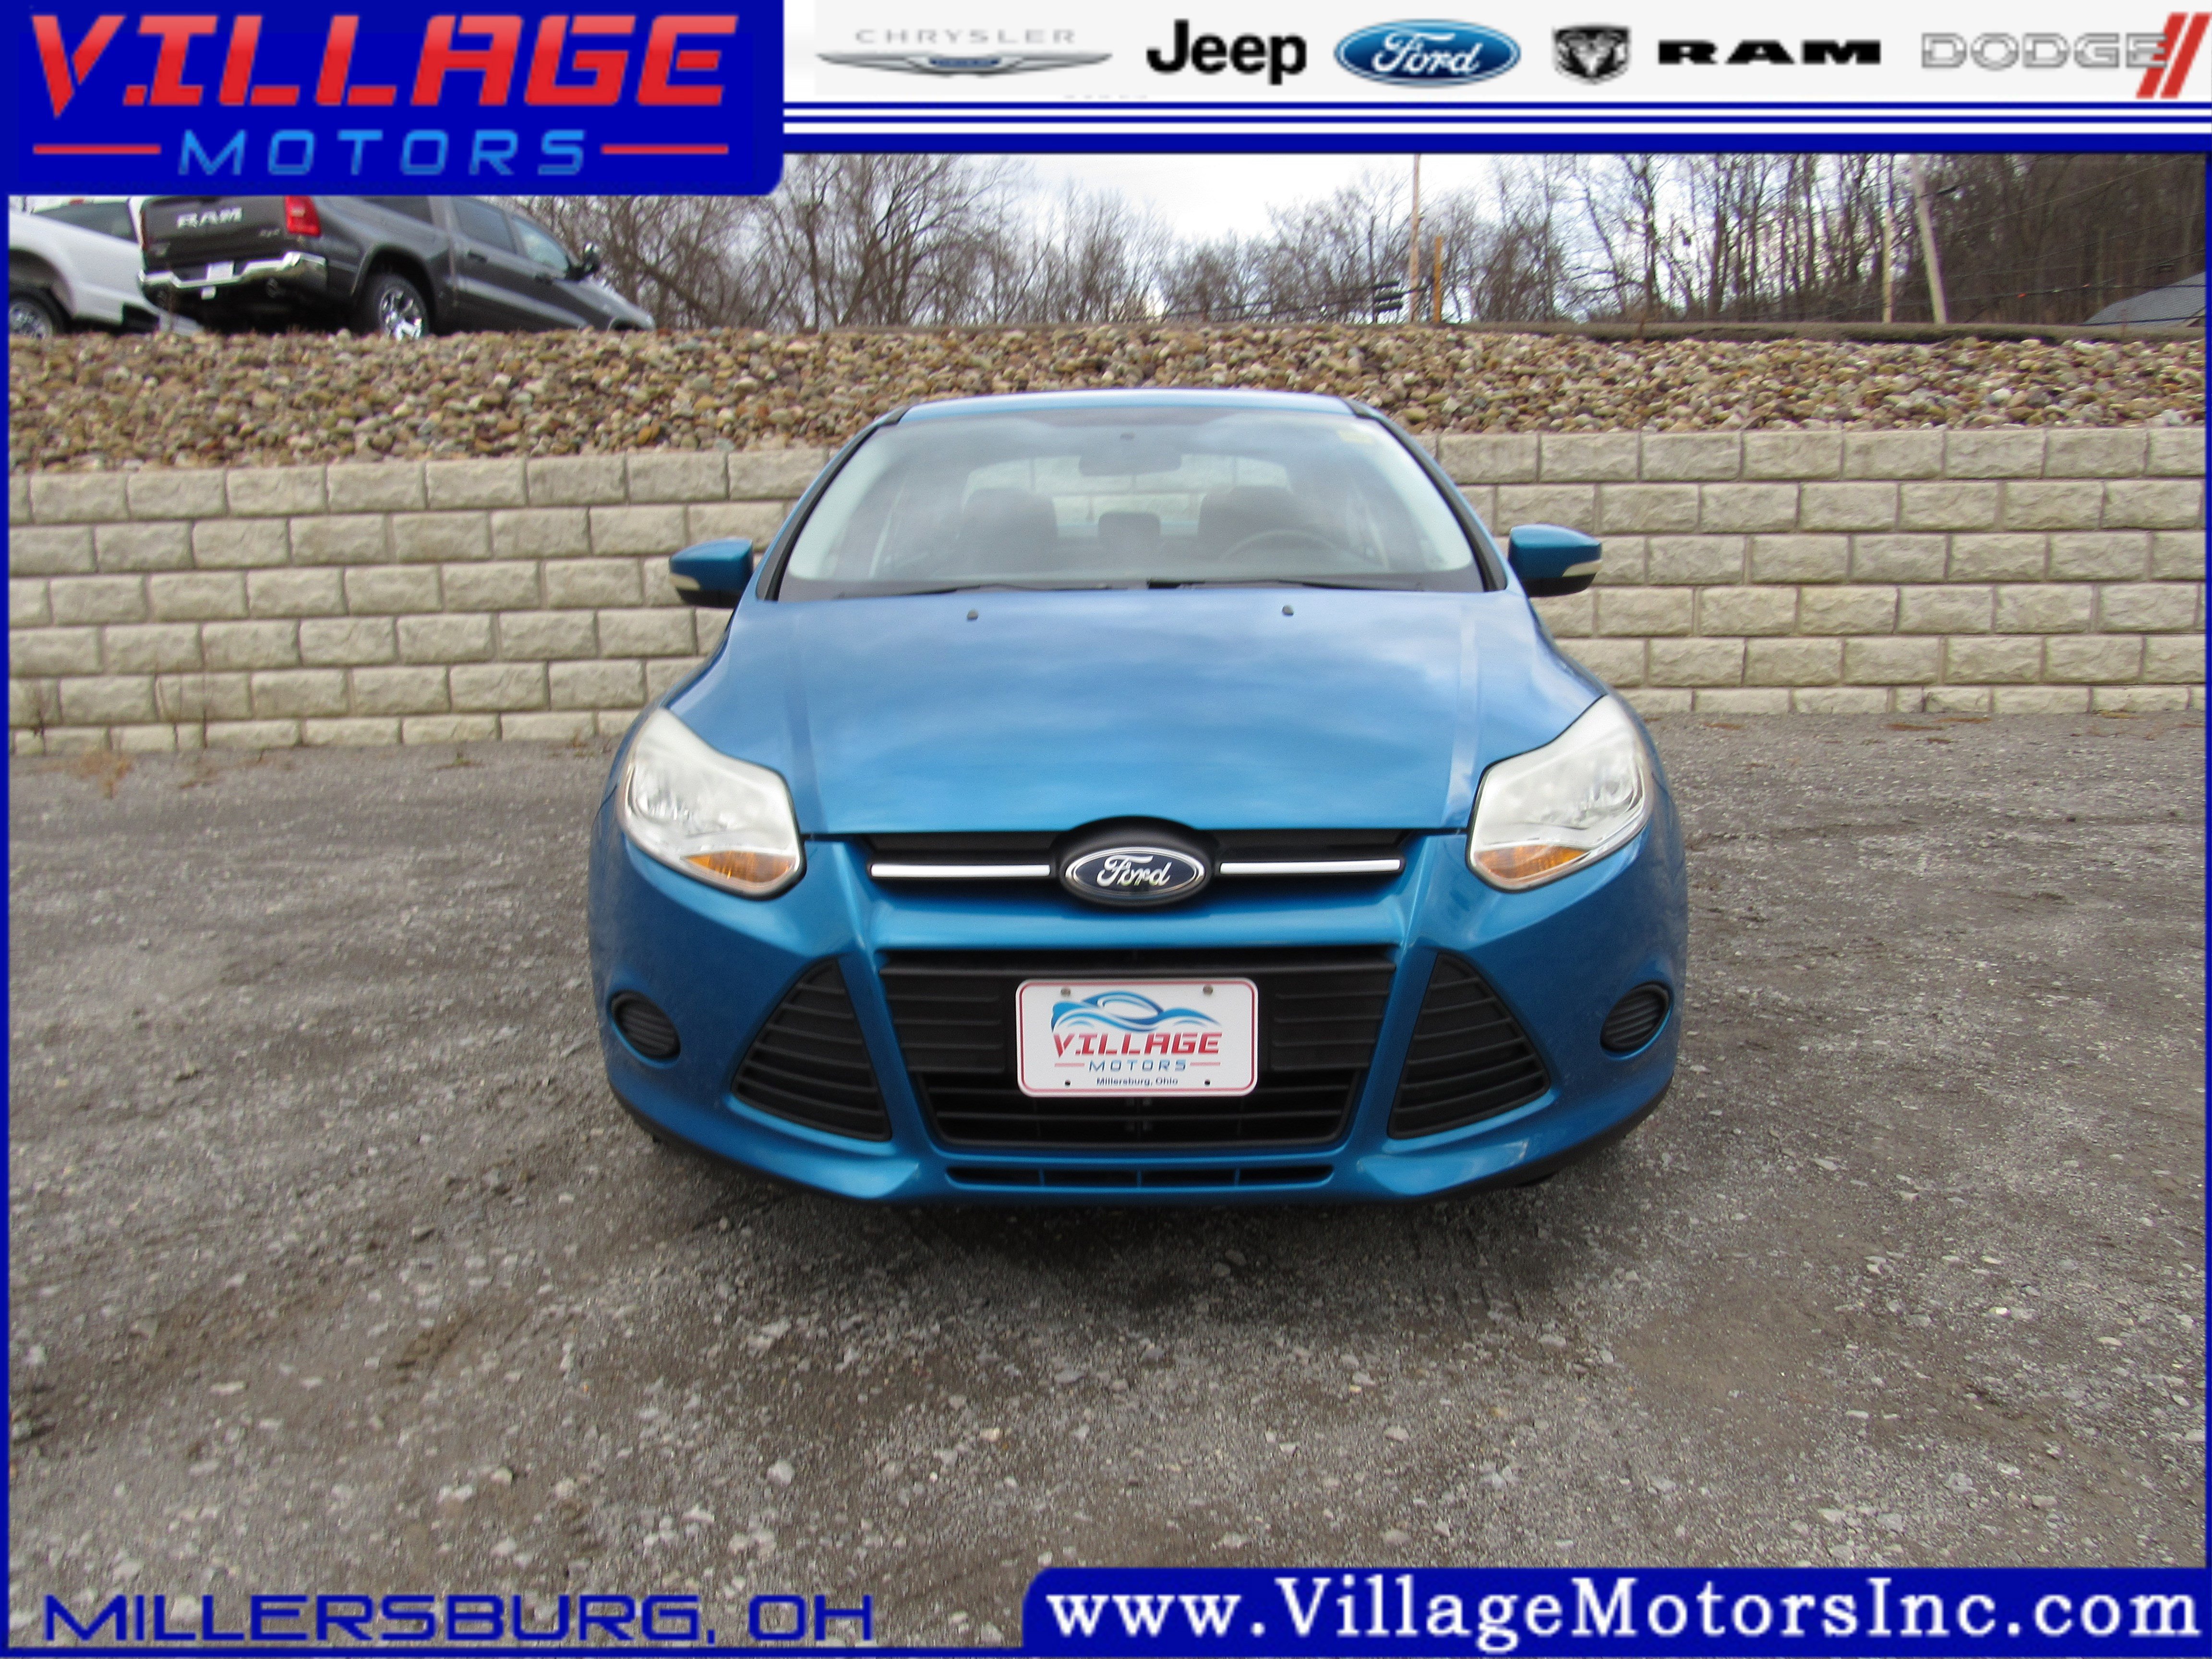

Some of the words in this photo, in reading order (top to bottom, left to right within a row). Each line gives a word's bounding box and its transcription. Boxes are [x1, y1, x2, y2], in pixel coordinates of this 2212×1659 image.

[177, 207, 242, 228] RAM
[1096, 854, 1172, 887] Ford
[1089, 1059, 1187, 1072] MOTORS
[1096, 1077, 1153, 1086] Millersburg,
[1155, 1077, 1178, 1085] Ohio
